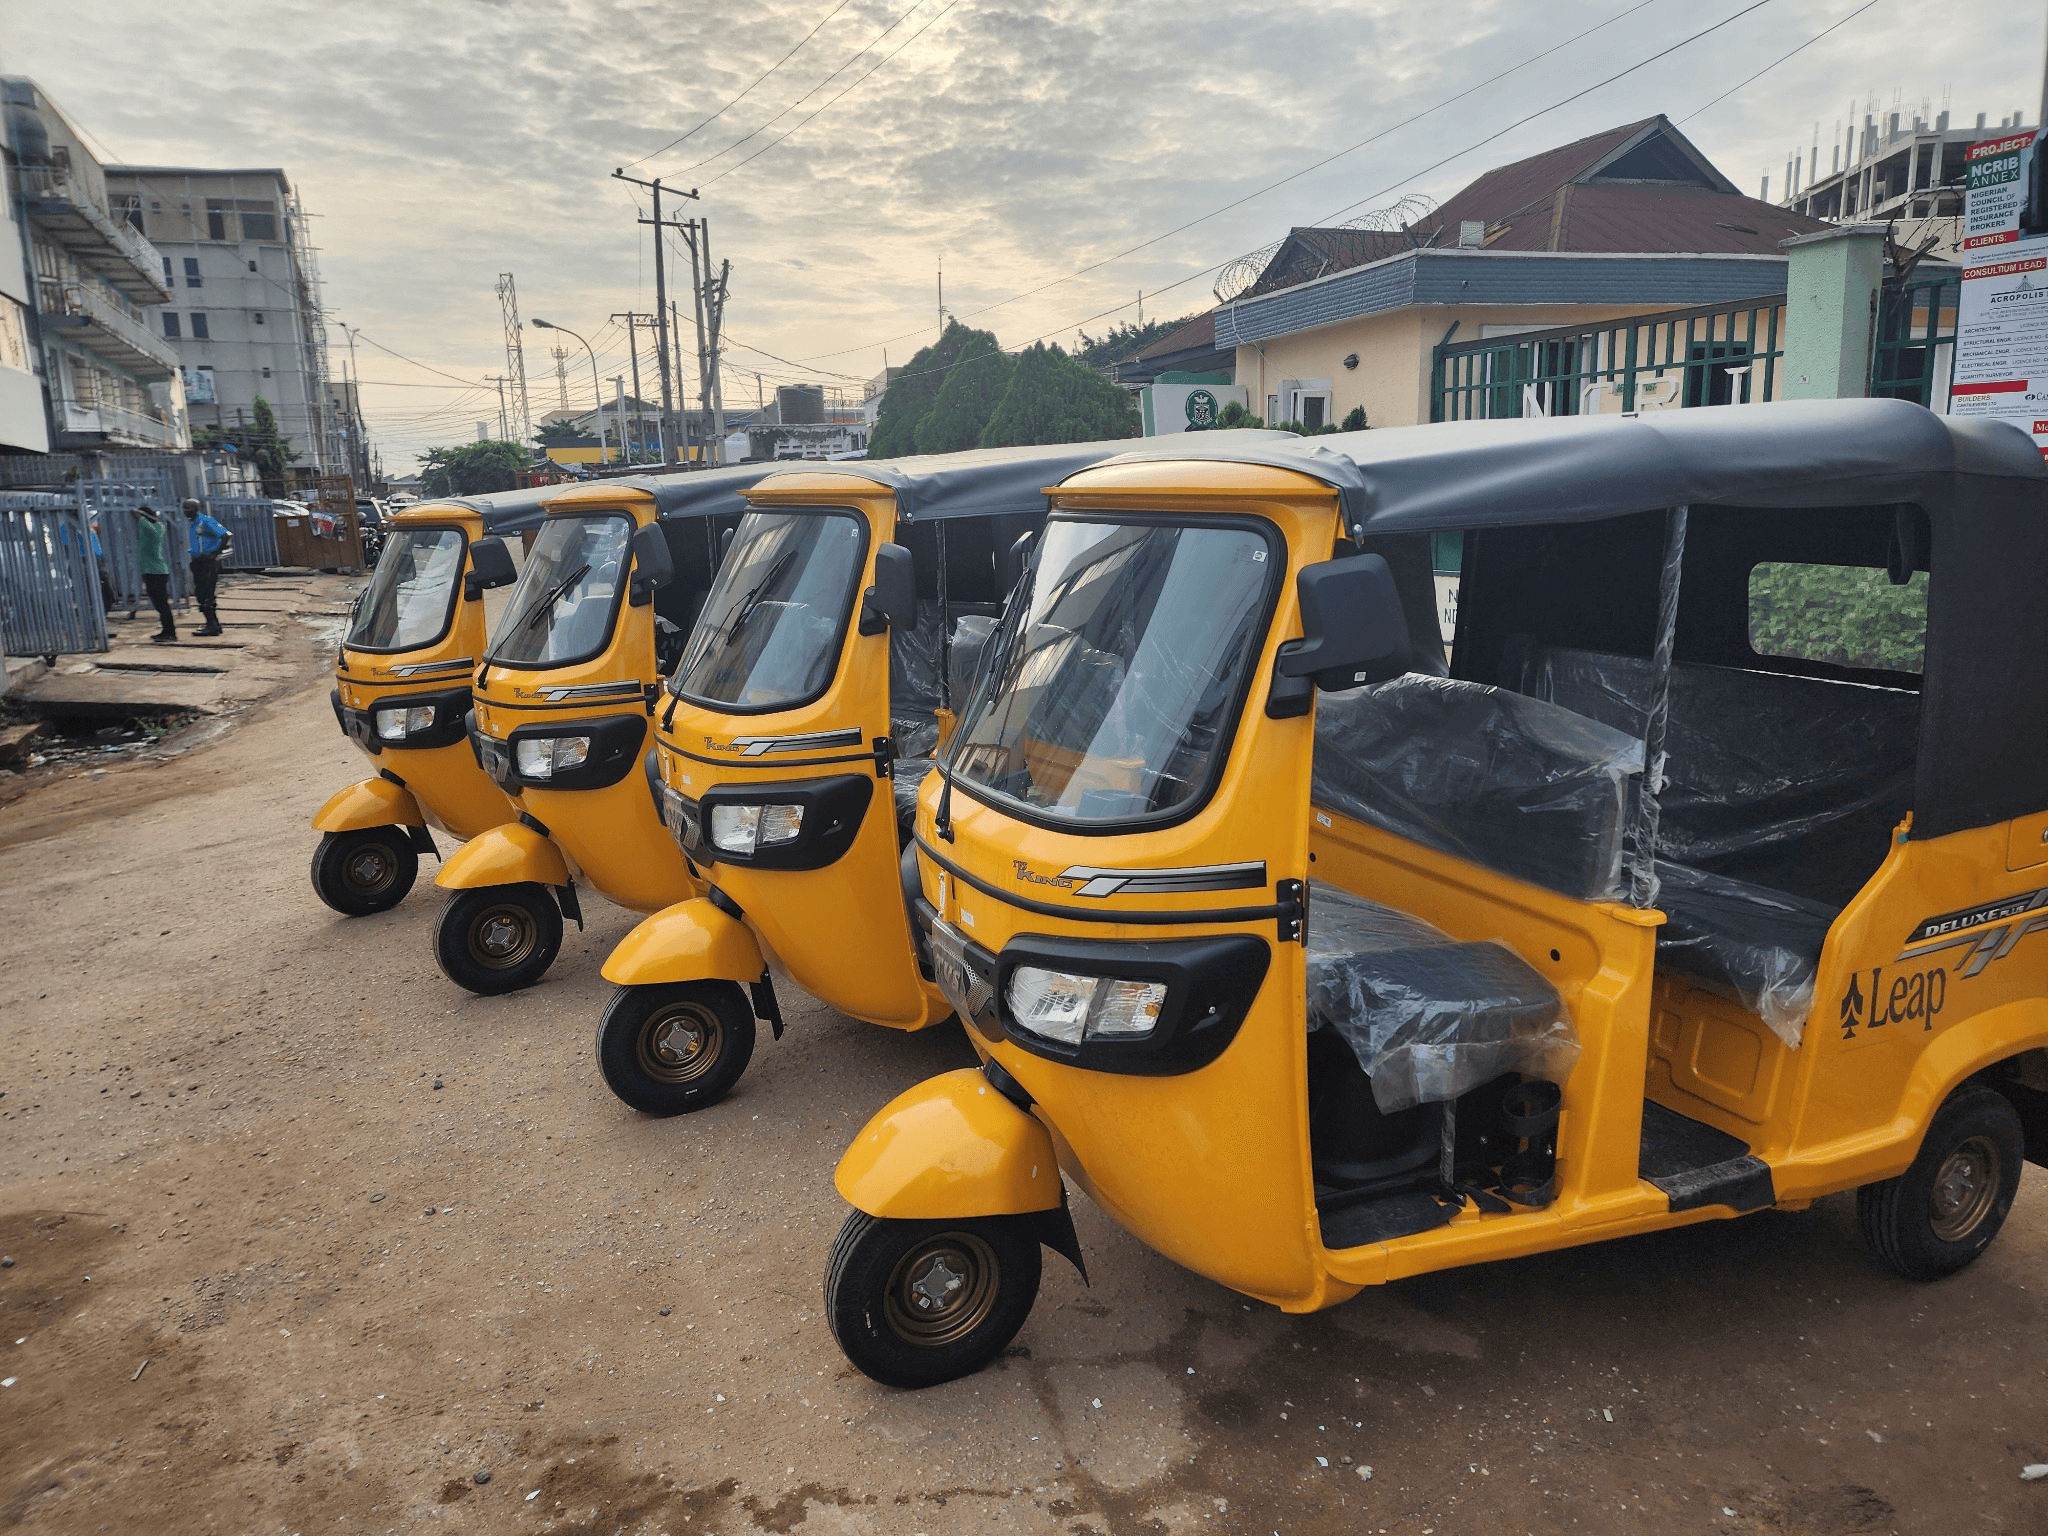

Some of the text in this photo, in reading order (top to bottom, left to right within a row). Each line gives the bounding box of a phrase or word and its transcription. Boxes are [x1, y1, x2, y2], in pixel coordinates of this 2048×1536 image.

[1972, 136, 2032, 159] PROJECT:
[1971, 156, 2019, 178] NCRIB
[1972, 169, 2018, 188] ANNEX
[1971, 186, 2008, 200] NIGERIAN
[1971, 192, 2016, 208] COUNCIL OF
[1970, 201, 2018, 215] REGISTERED
[1970, 210, 2015, 224] INSURANCE
[1970, 220, 2006, 232] BROKERS
[1970, 233, 2007, 247] CLIENTS:
[2018, 260, 2046, 271] LEAD:
[1990, 291, 2044, 304] ACROPOLIS
[1963, 338, 1996, 347] STRUCTURAL
[1957, 395, 1993, 403] BUILDERS:
[1017, 868, 1073, 889] KING
[1925, 905, 2025, 938] DELUXE PLUS
[1867, 967, 1947, 1031] Leap
